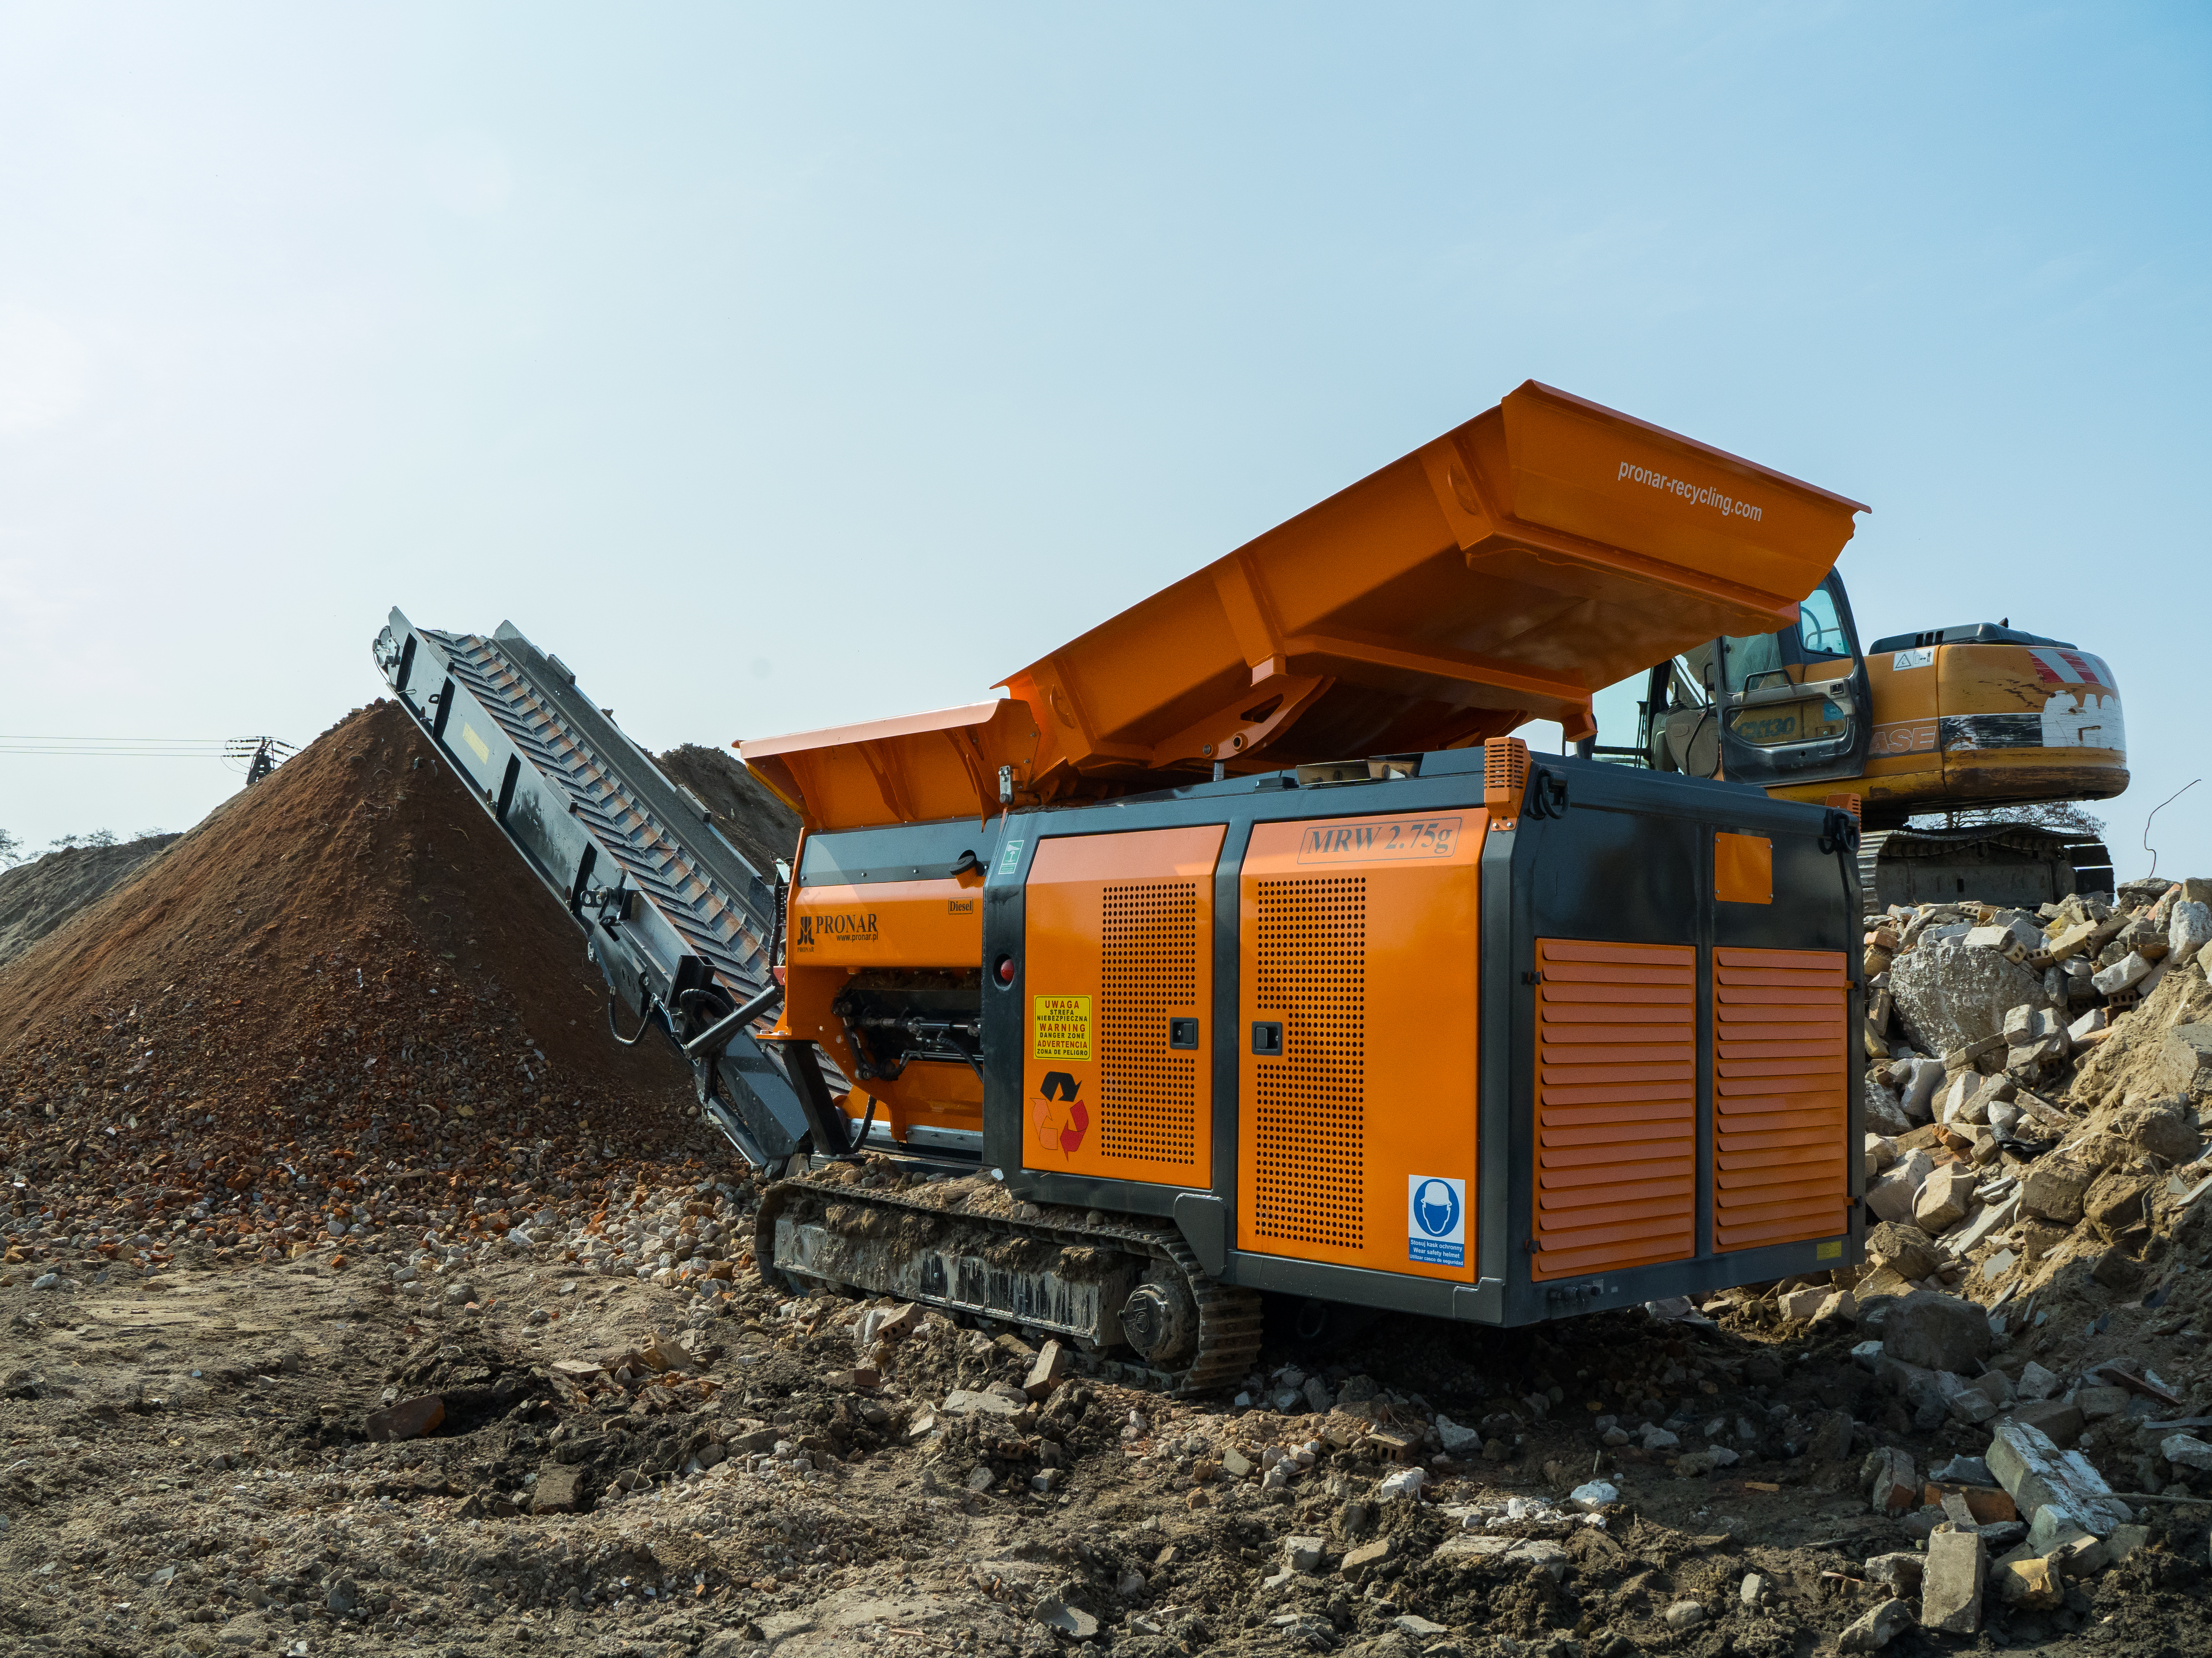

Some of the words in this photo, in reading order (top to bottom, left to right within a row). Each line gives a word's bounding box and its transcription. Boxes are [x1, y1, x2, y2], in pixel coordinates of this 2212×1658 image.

[1618, 461, 1762, 521] pronar-recycling.com
[1868, 726, 1936, 754] ASE
[1306, 827, 1383, 854] MRW
[1384, 823, 1453, 854] 2.75g
[950, 900, 972, 911] Diesel
[815, 914, 878, 933] PRONAR
[836, 932, 878, 943] www.pronar.pl
[1045, 1000, 1079, 1008] UWAGA
[1039, 1023, 1085, 1032] WARNING
[1037, 1040, 1088, 1048] ADVERTENCIA
